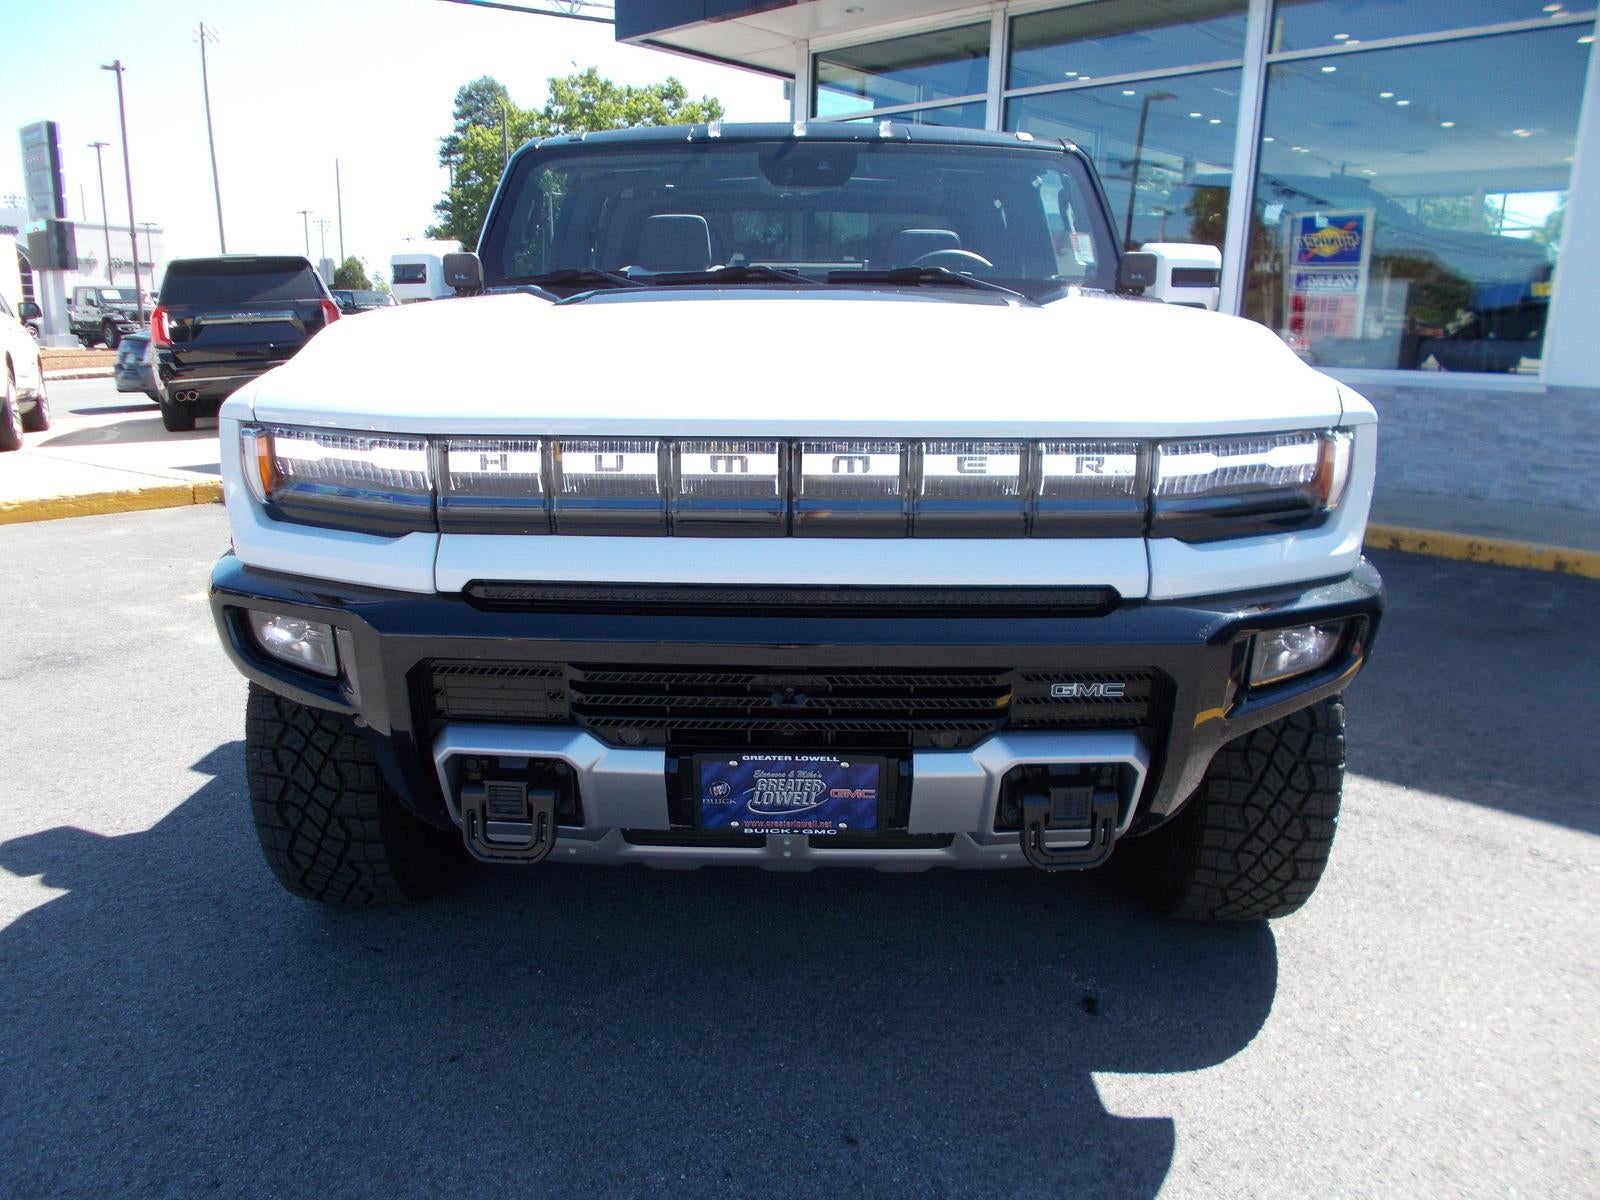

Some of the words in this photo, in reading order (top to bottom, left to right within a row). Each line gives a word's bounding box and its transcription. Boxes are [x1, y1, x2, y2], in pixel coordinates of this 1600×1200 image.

[1051, 682, 1126, 697] GMC
[756, 778, 822, 792] GREATER
[752, 791, 817, 805] LOWELL
[830, 788, 876, 799] GMC
[743, 820, 832, 828] www.greaterlowell.net
